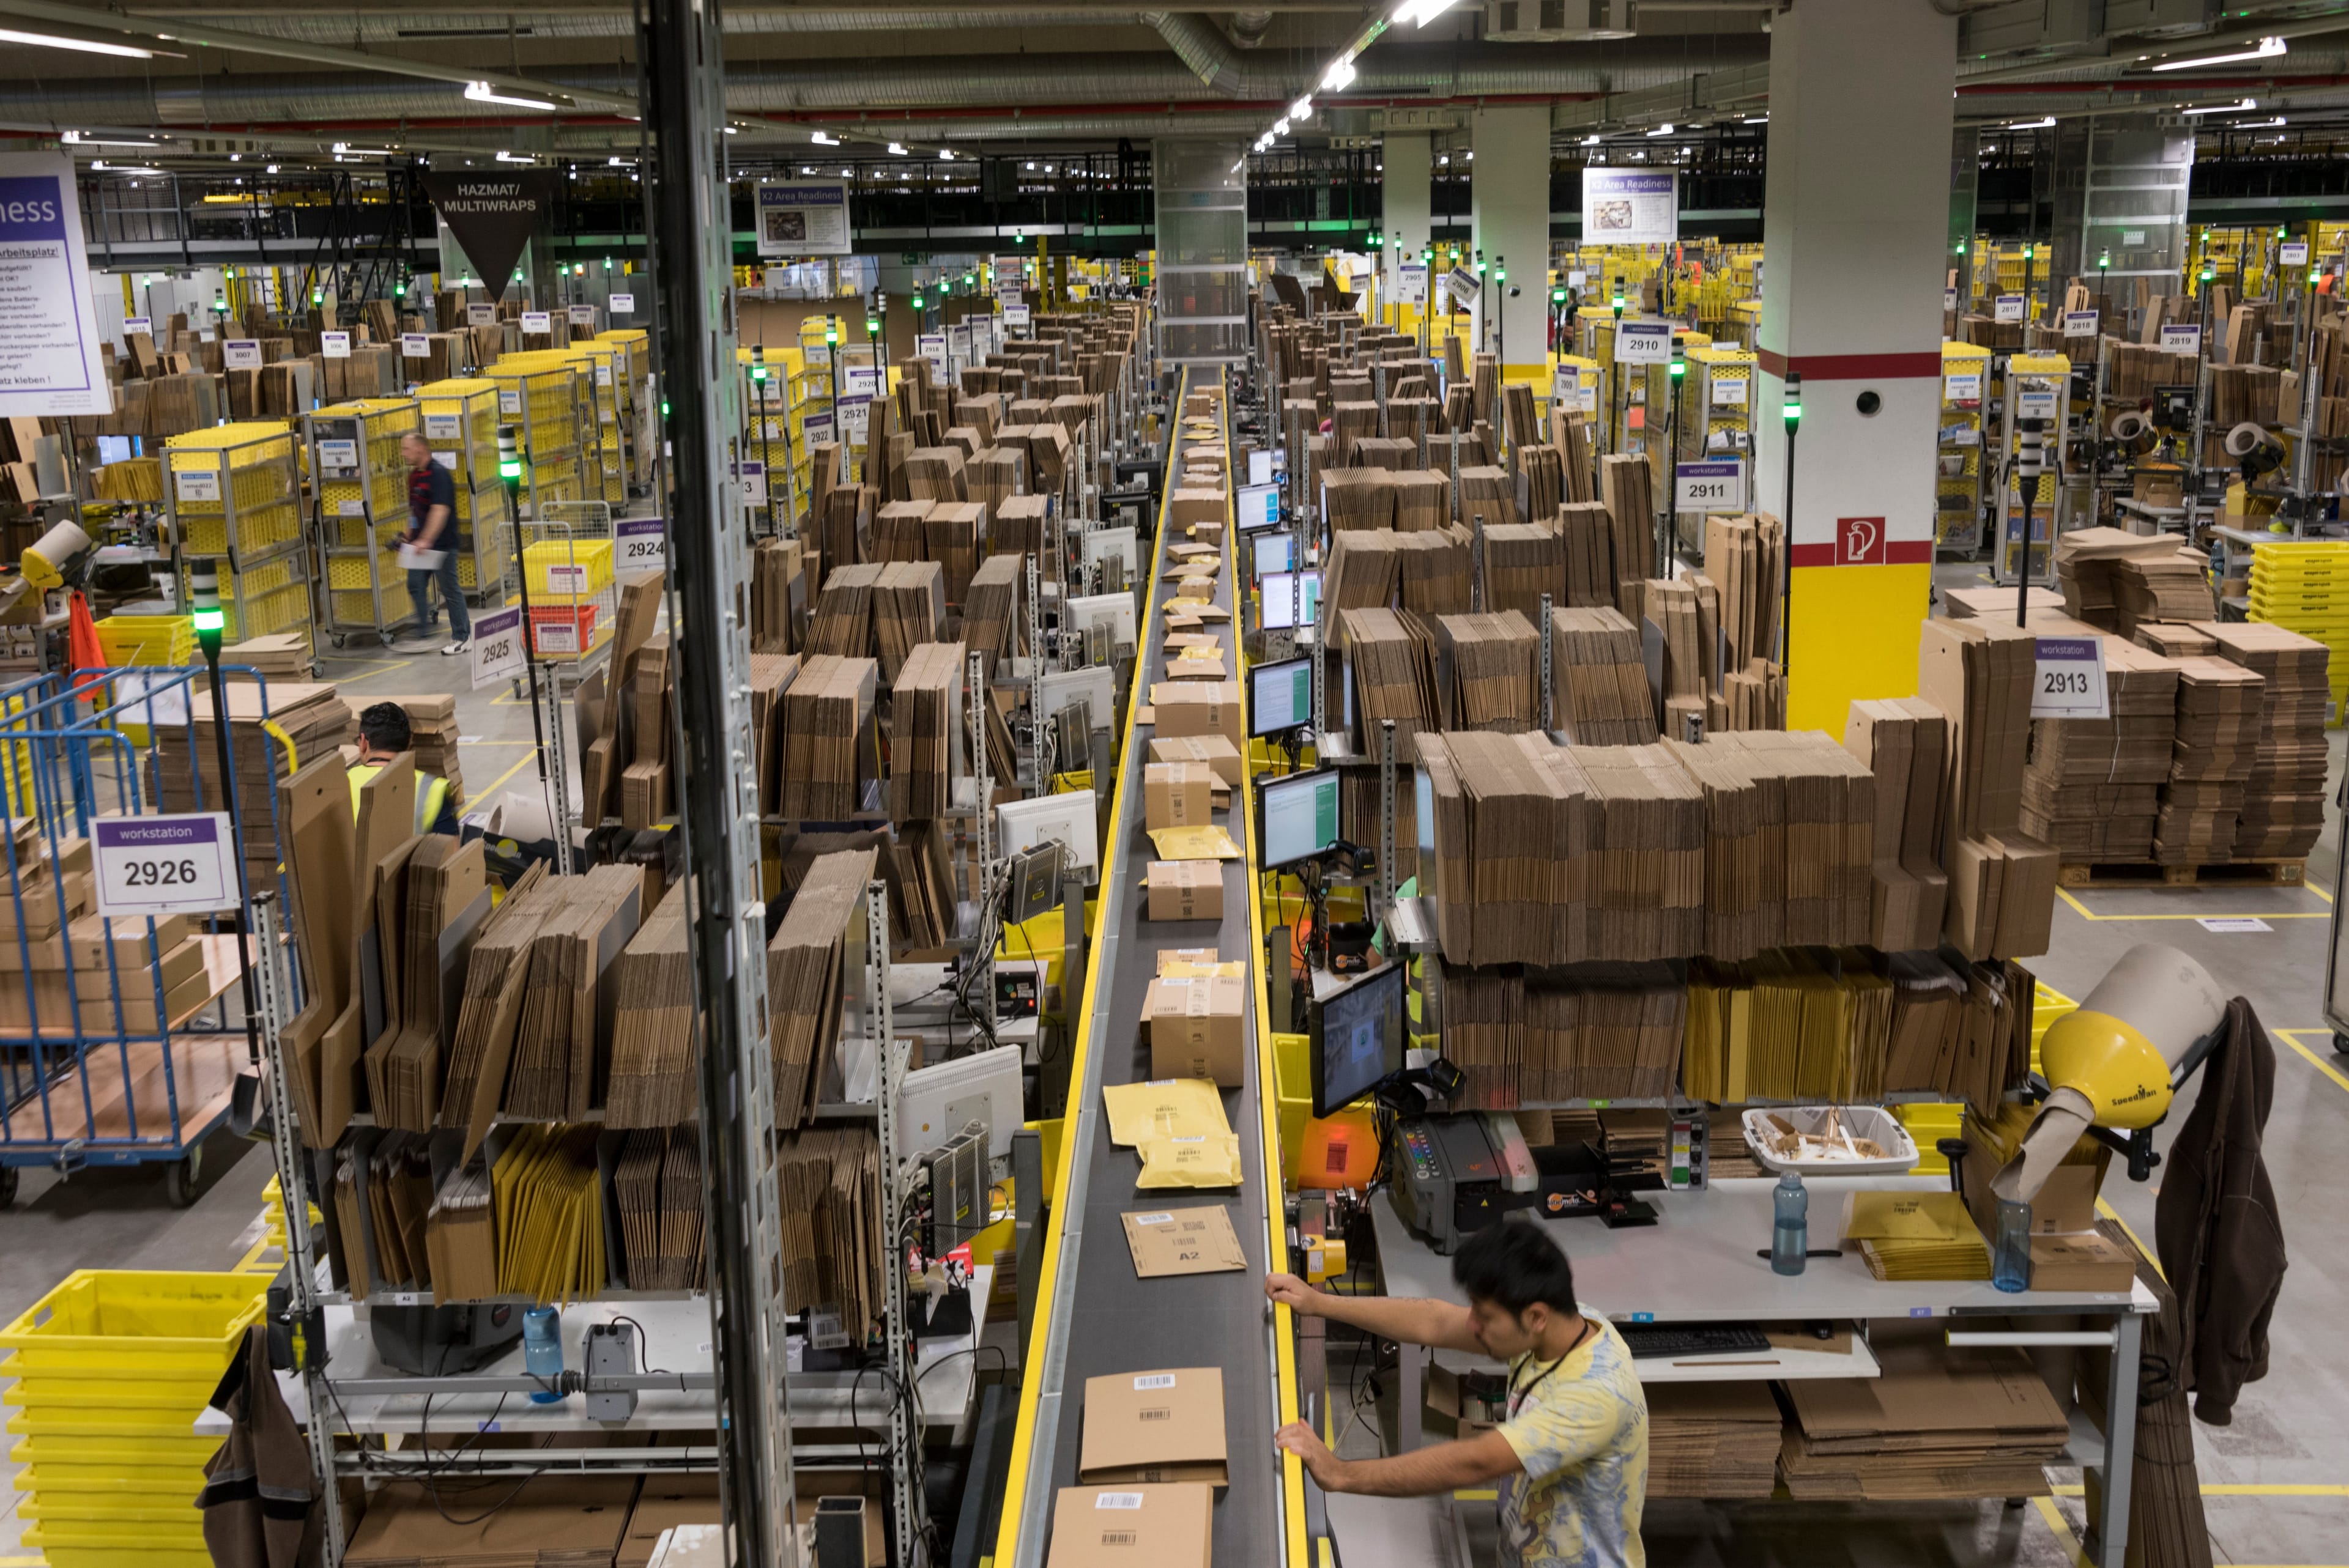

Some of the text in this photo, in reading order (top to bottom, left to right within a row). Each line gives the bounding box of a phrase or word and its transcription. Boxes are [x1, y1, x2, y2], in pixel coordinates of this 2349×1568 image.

[458, 184, 520, 196] HAZMAT/
[1591, 179, 1671, 190] X2 Area Readiness
[798, 191, 842, 200] Readiness
[444, 200, 536, 212] MULTIWRAPS
[1632, 325, 1659, 334] workstation
[1630, 340, 1658, 351] 2910
[844, 409, 867, 420] 2921
[811, 431, 828, 443] 2922
[1689, 484, 1724, 498] 2911
[628, 541, 665, 557] 2924
[483, 616, 512, 632] workstation
[483, 640, 509, 665] 2925
[2041, 645, 2085, 655] workstation
[2044, 673, 2087, 693] 2913
[119, 826, 192, 840] workstation
[124, 859, 197, 886] 2926
[2112, 1084, 2157, 1106] SpeedMan
[1179, 1251, 1201, 1260] A2
